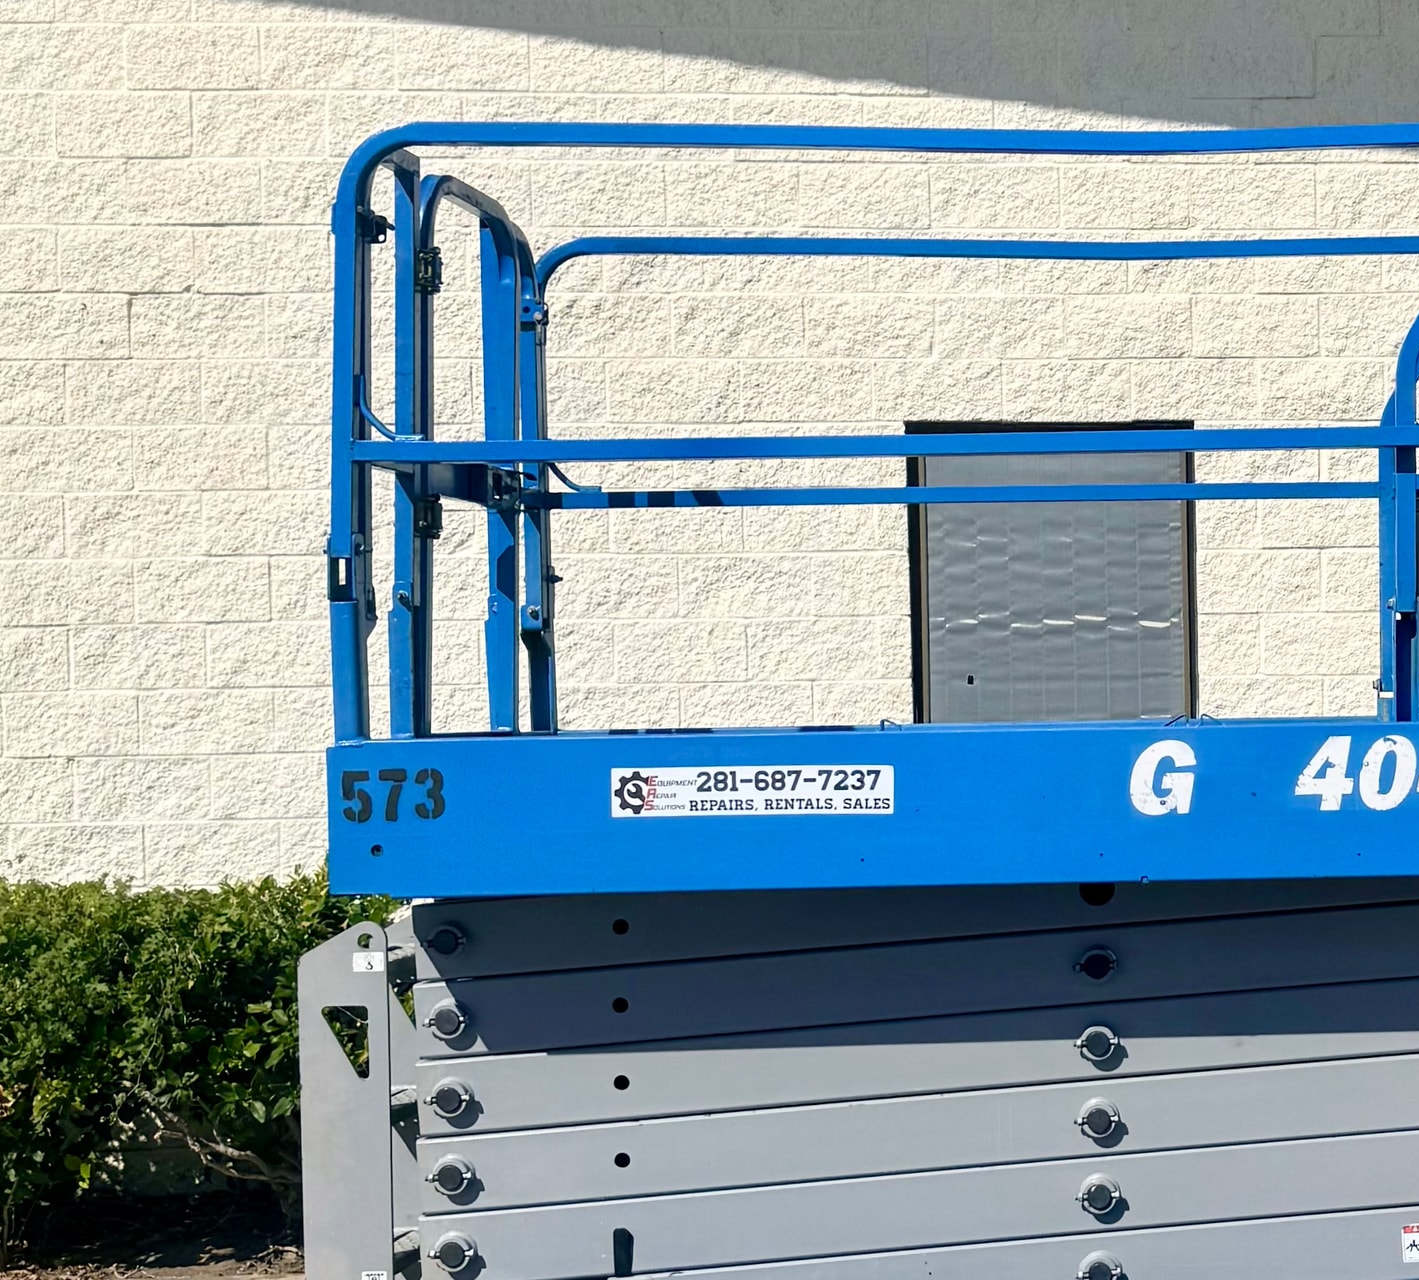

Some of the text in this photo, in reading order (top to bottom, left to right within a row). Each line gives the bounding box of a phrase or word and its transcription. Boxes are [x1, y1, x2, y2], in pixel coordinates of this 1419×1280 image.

[341, 768, 446, 823] 573
[696, 769, 882, 793] 281-687-7237
[1129, 740, 1197, 815] G
[689, 798, 891, 812] REPAIRS, RENTALS, SALES
